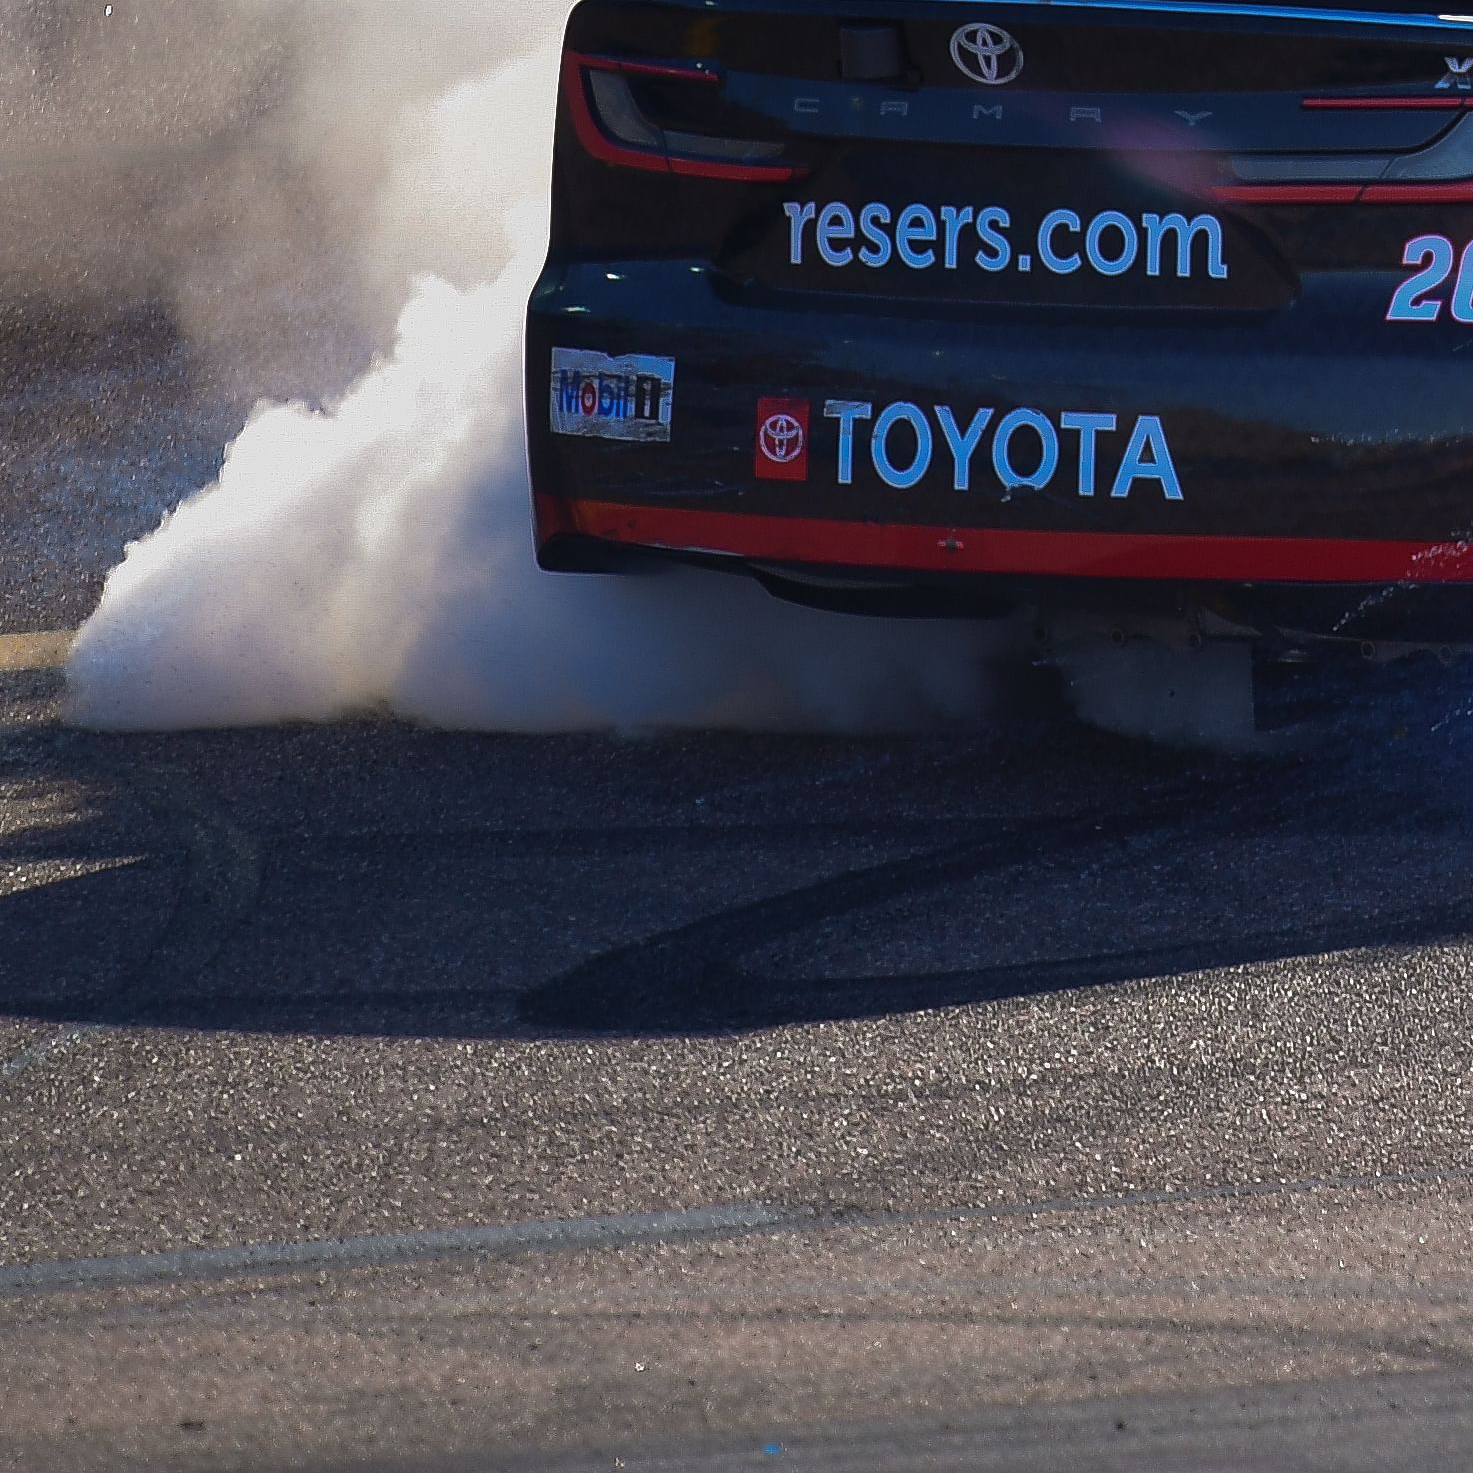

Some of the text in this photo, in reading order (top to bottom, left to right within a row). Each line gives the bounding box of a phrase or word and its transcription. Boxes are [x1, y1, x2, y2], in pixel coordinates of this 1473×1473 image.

[794, 97, 1213, 127] CAMRY
[782, 200, 1228, 279] resers.com
[559, 368, 629, 417] Mobil
[823, 398, 1185, 502] TOYOTA
